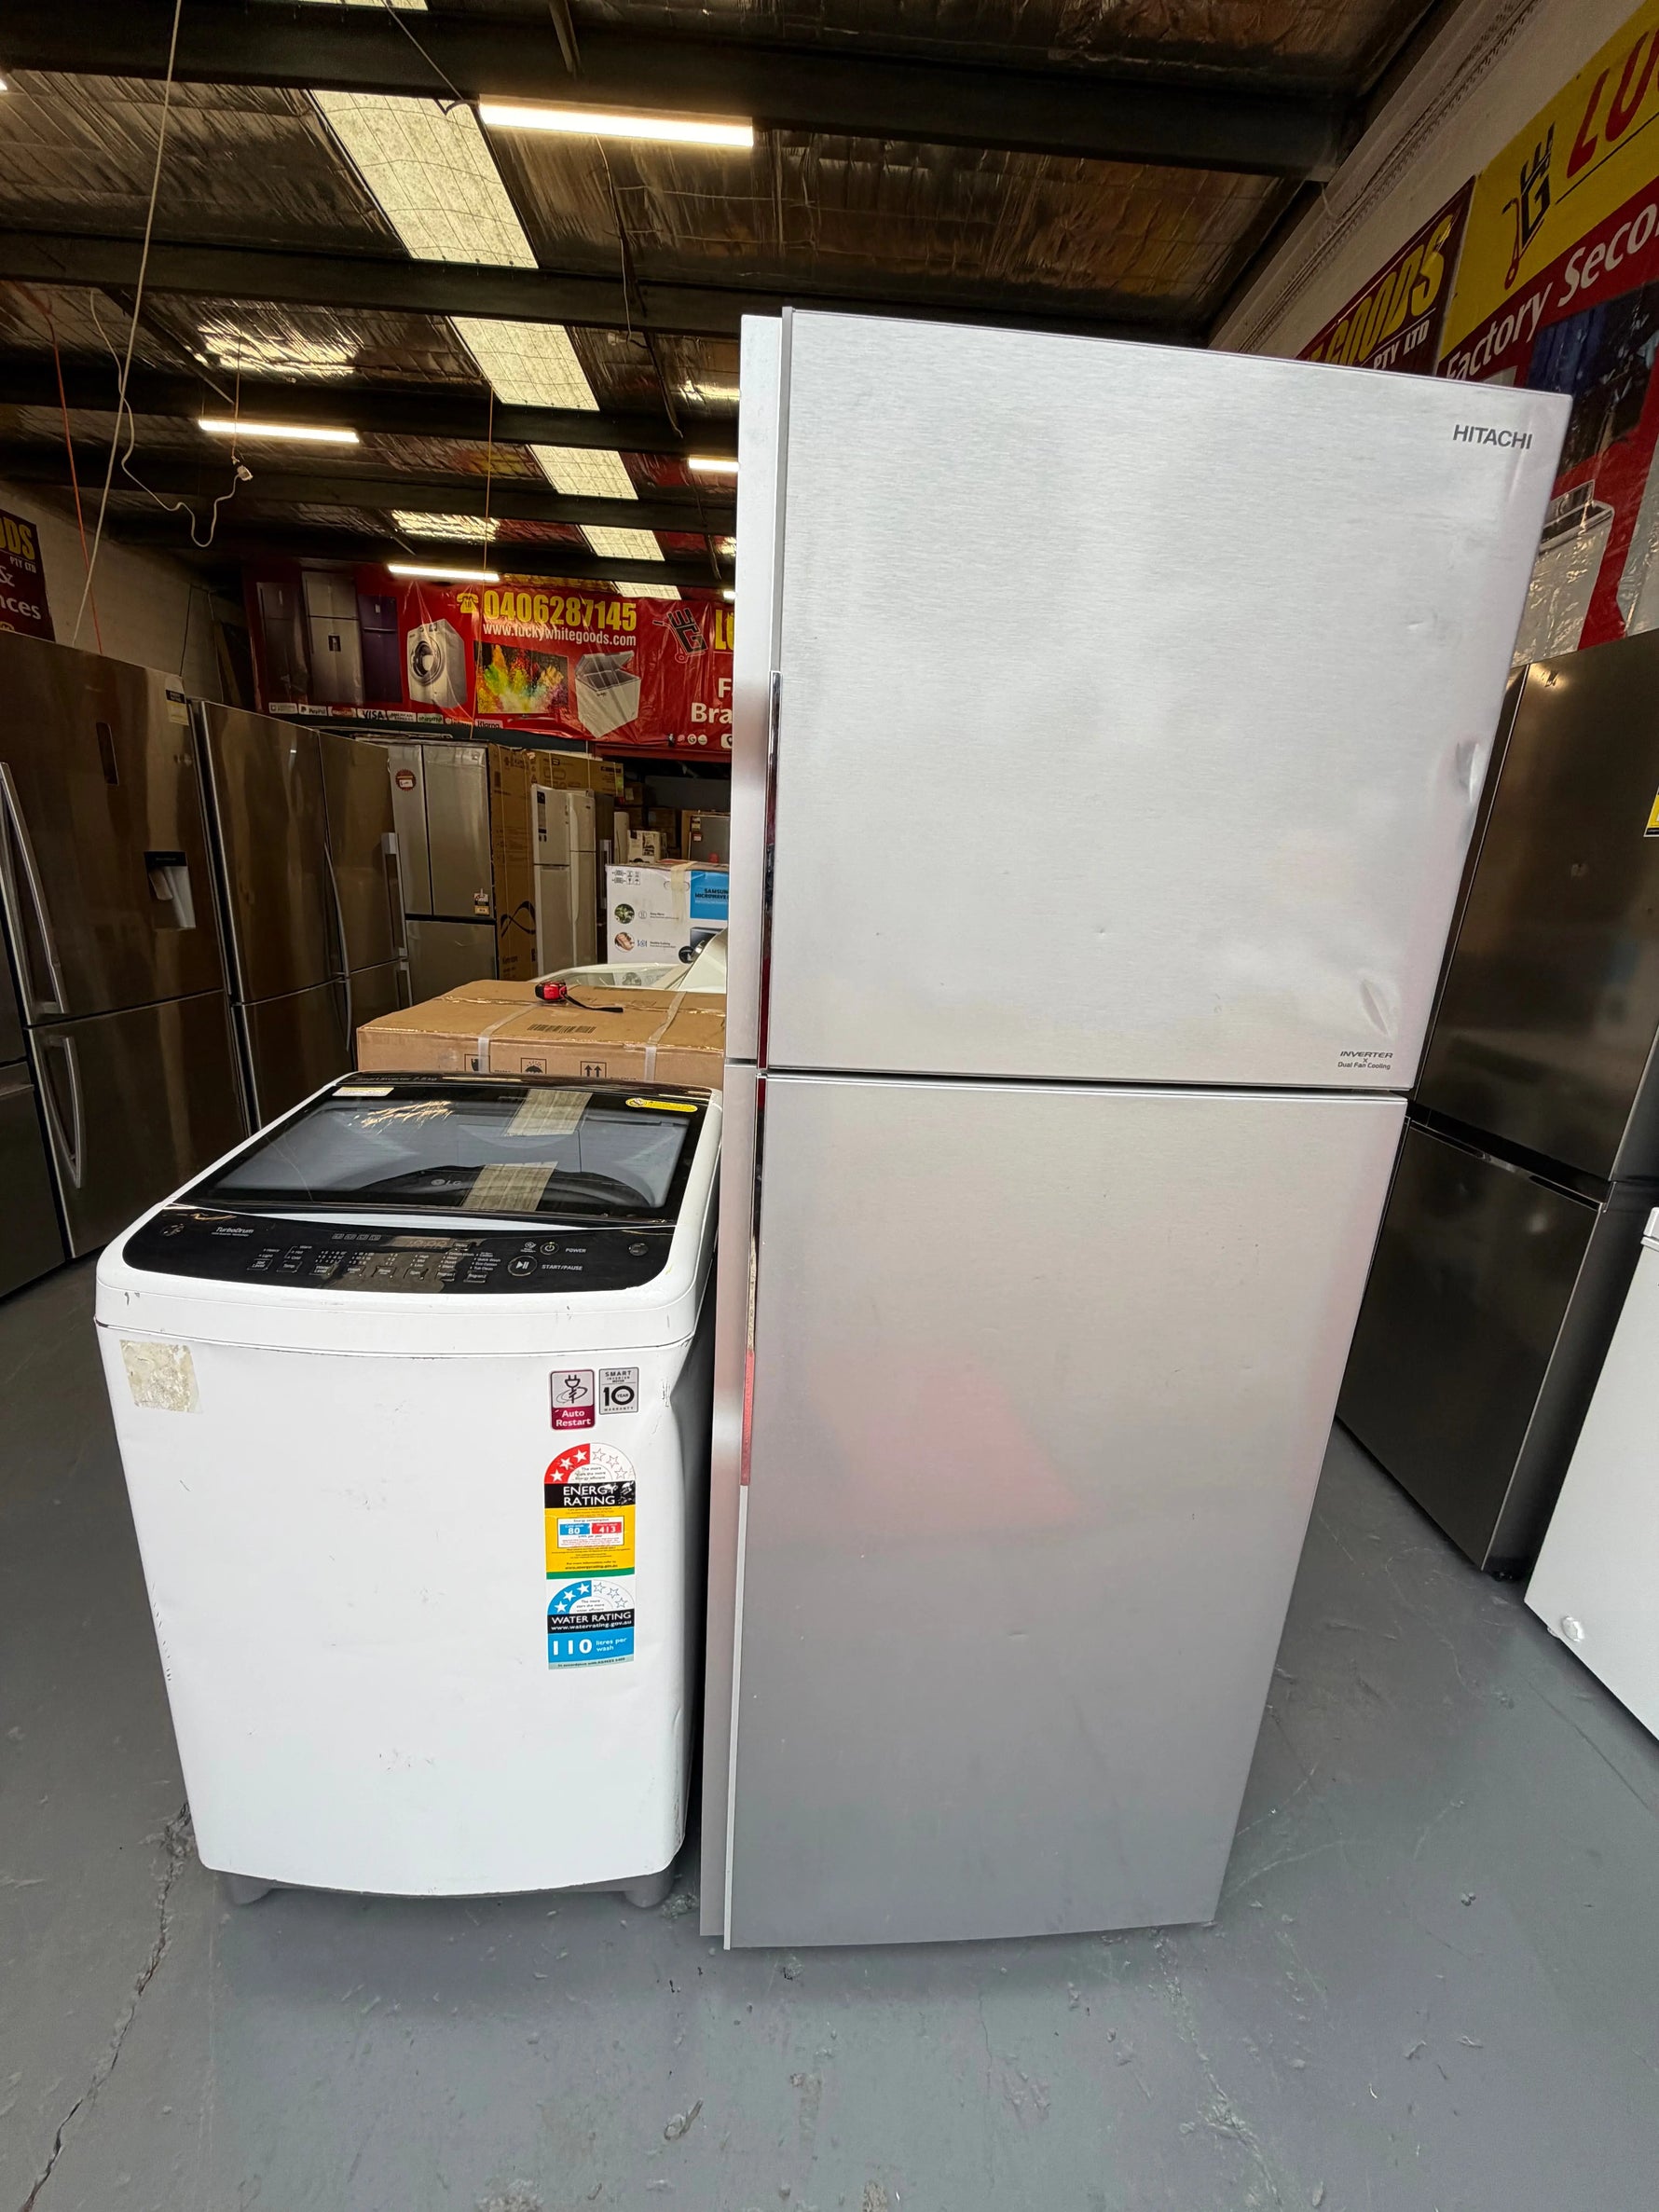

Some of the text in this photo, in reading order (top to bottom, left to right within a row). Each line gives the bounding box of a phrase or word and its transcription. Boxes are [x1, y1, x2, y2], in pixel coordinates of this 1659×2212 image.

[1567, 28, 1659, 179] LU
[1446, 202, 1659, 379] Factory Seco
[1404, 319, 1430, 355] LTD
[1452, 424, 1533, 449] HITACHI
[483, 590, 637, 631] 0406287145
[483, 623, 637, 646] www.luckywhitegoods.com
[718, 678, 733, 698] F
[363, 710, 385, 720] VISA
[1340, 1051, 1393, 1059] INVERTER
[215, 1226, 254, 1234] TurboDrum
[603, 1385, 635, 1407] 10
[561, 1409, 585, 1418] Auto
[555, 1418, 592, 1427] Restart
[563, 1484, 617, 1496] ENERGY
[563, 1495, 616, 1506] RATING
[551, 1620, 632, 1630] www.waterrating.gov.au
[552, 1611, 632, 1625] WATER RATING
